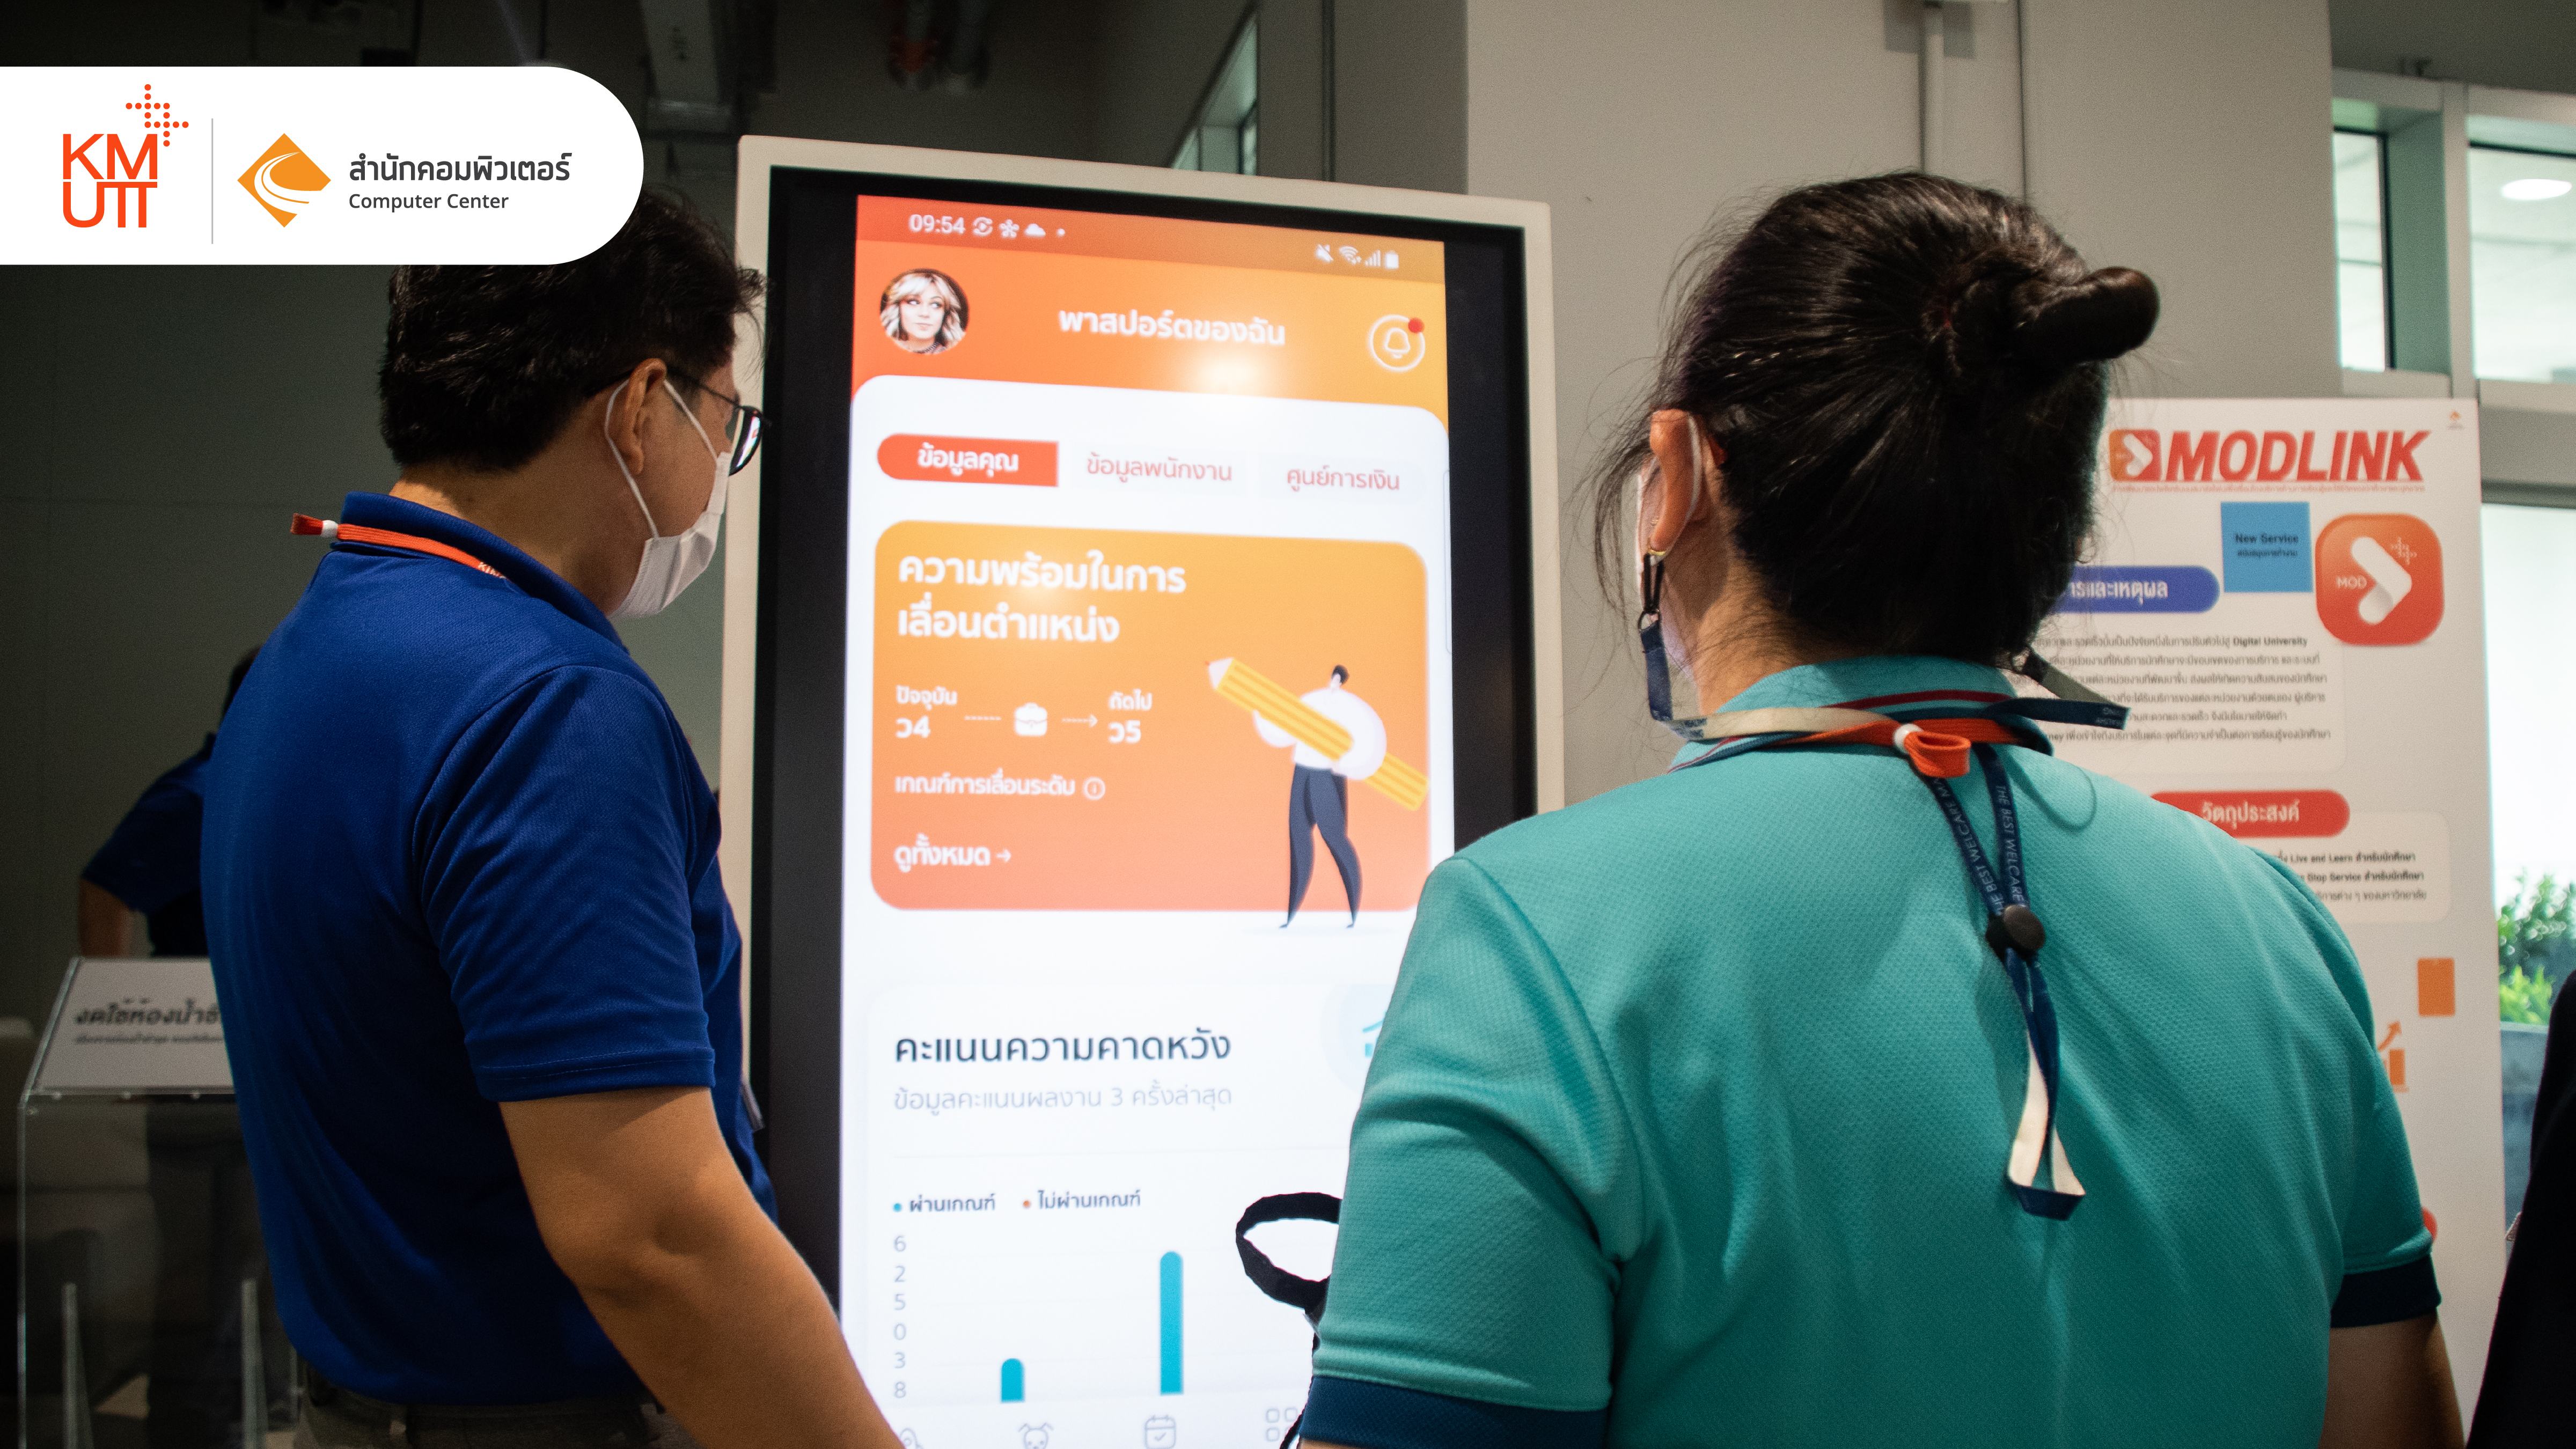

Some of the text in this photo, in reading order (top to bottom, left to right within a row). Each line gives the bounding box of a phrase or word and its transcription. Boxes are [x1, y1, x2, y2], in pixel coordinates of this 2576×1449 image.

[908, 214, 966, 234] 09:54
[1059, 309, 1286, 346] พาสปอร์ตของฉัน
[916, 442, 1400, 492] ข้อมูลคุณ ข้อมูลพนักงาน ศูนย์การเงิน
[2165, 430, 2432, 482] MODLINK
[2235, 532, 2299, 544] New Service
[899, 549, 1186, 593] ความพร้อมในการ
[2336, 576, 2367, 590] MOD
[2069, 581, 2168, 605] ารและเหตุผล
[899, 592, 1120, 642] เลื่อนตำแหน่ง
[2233, 636, 2261, 648] Digital
[2264, 636, 2308, 648] University
[896, 685, 1153, 711] ปัจจุบัน ถัดไป
[895, 768, 1076, 796] เกณฑ์การเลื่อนระดับ
[2202, 799, 2300, 830] วัตถุประสงค์
[1944, 801, 1981, 863] WELCARE
[1995, 785, 2025, 903] THE BEST WELCARE
[894, 833, 991, 873] ดูทั้งหมด
[2290, 854, 2308, 862] Live
[2311, 853, 2326, 862] and
[2329, 854, 2353, 862] Learn
[1976, 865, 1998, 893] BEST
[2330, 873, 2361, 881] Service
[896, 1027, 1231, 1062] คะแนนความคาดหวัง
[894, 1079, 1232, 1116] ข้อมูลคะแนนผลงาน 3 ครั้งล่าสุด
[909, 1189, 1141, 1212] ผ่านเกณฑ์ ไม่ผ่านเกณฑ์
[893, 1234, 907, 1253] 6
[894, 1265, 906, 1283] 2
[894, 1293, 906, 1311] 5
[893, 1322, 907, 1341] 0
[894, 1351, 906, 1369] 3
[893, 1381, 907, 1399] 8
